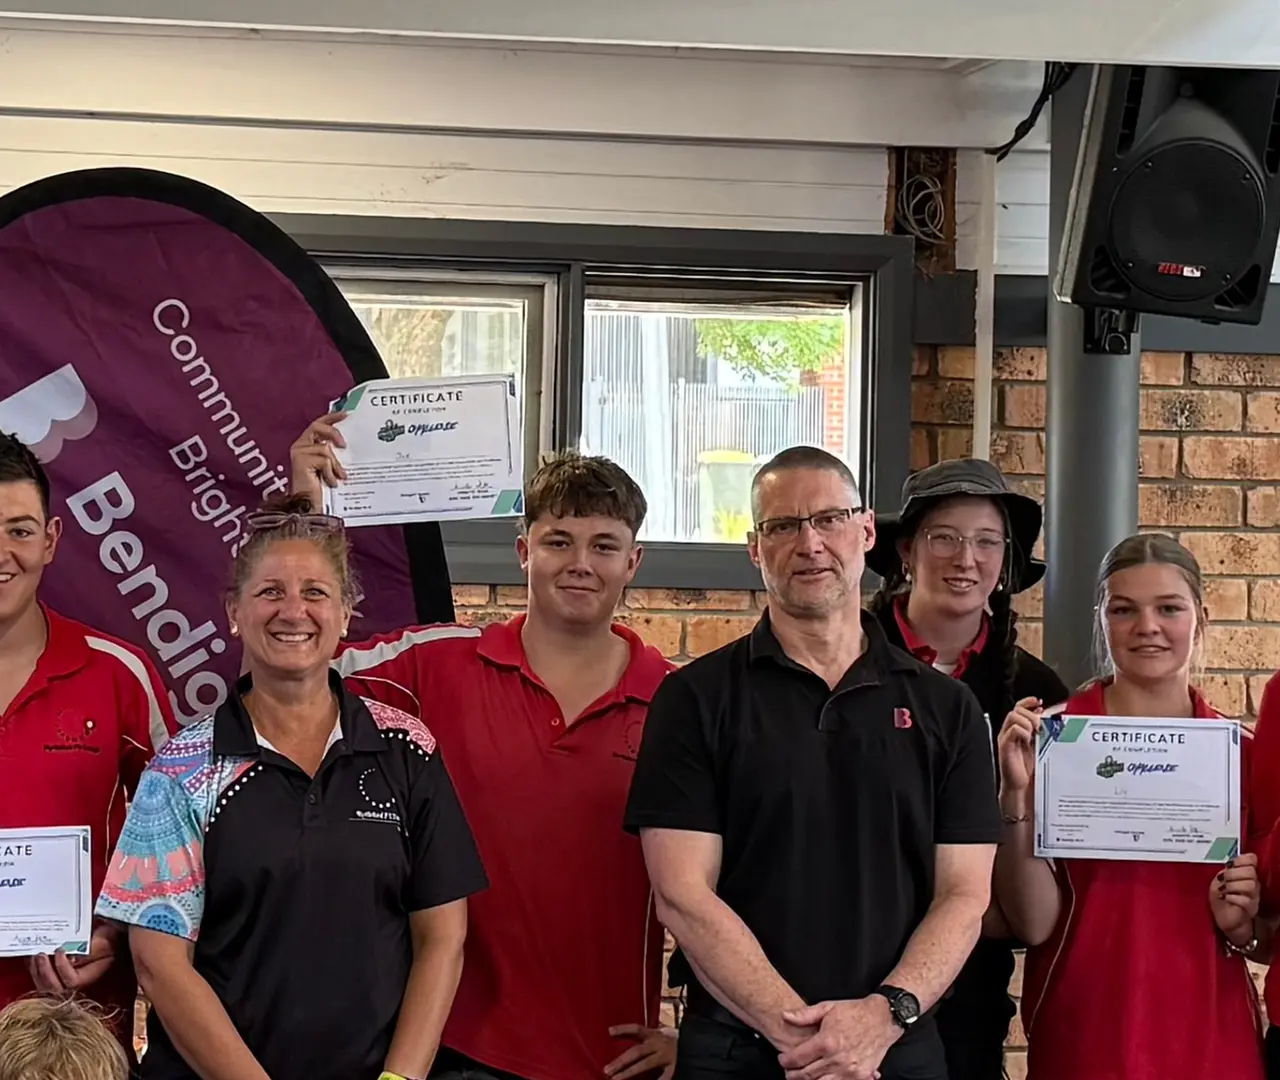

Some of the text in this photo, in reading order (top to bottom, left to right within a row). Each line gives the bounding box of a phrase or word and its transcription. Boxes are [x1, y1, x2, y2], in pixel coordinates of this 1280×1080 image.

[153, 299, 288, 503] Communit
[370, 390, 464, 407] CERTIFICATE
[66, 471, 228, 727] Bendig
[1092, 731, 1186, 745] CERTIFICATE
